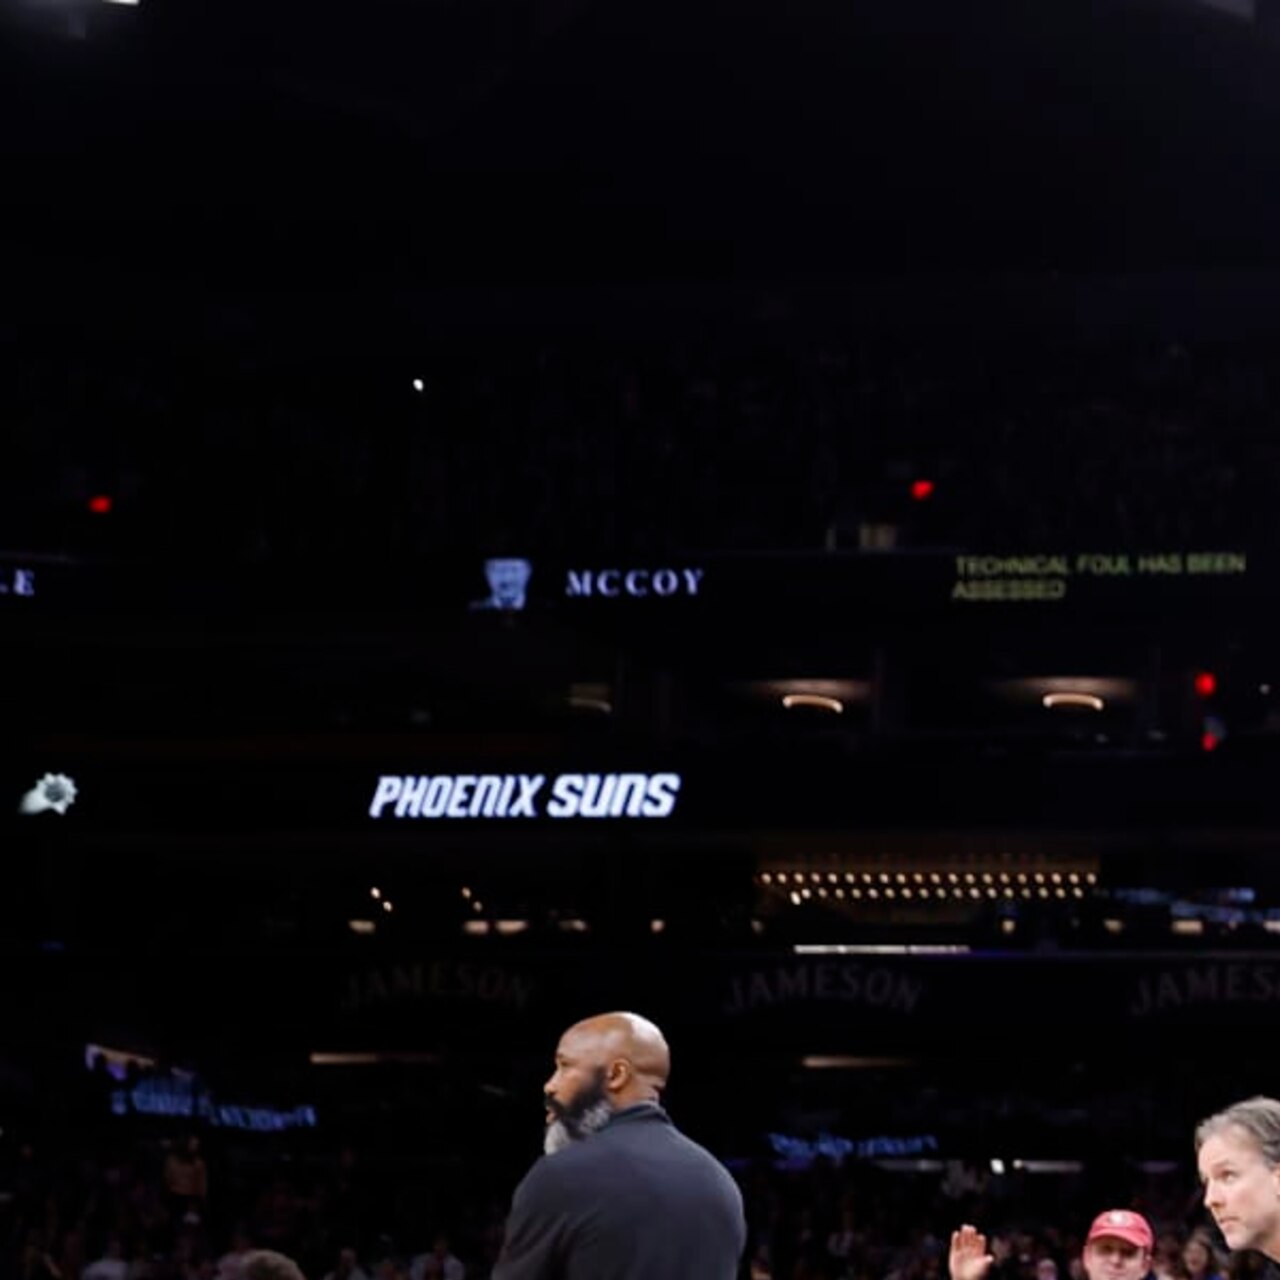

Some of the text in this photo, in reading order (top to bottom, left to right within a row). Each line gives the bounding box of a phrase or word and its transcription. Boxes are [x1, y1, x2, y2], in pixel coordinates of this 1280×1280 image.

[565, 568, 704, 597] MCCOY
[369, 773, 682, 818] PHOENIX SUNS
